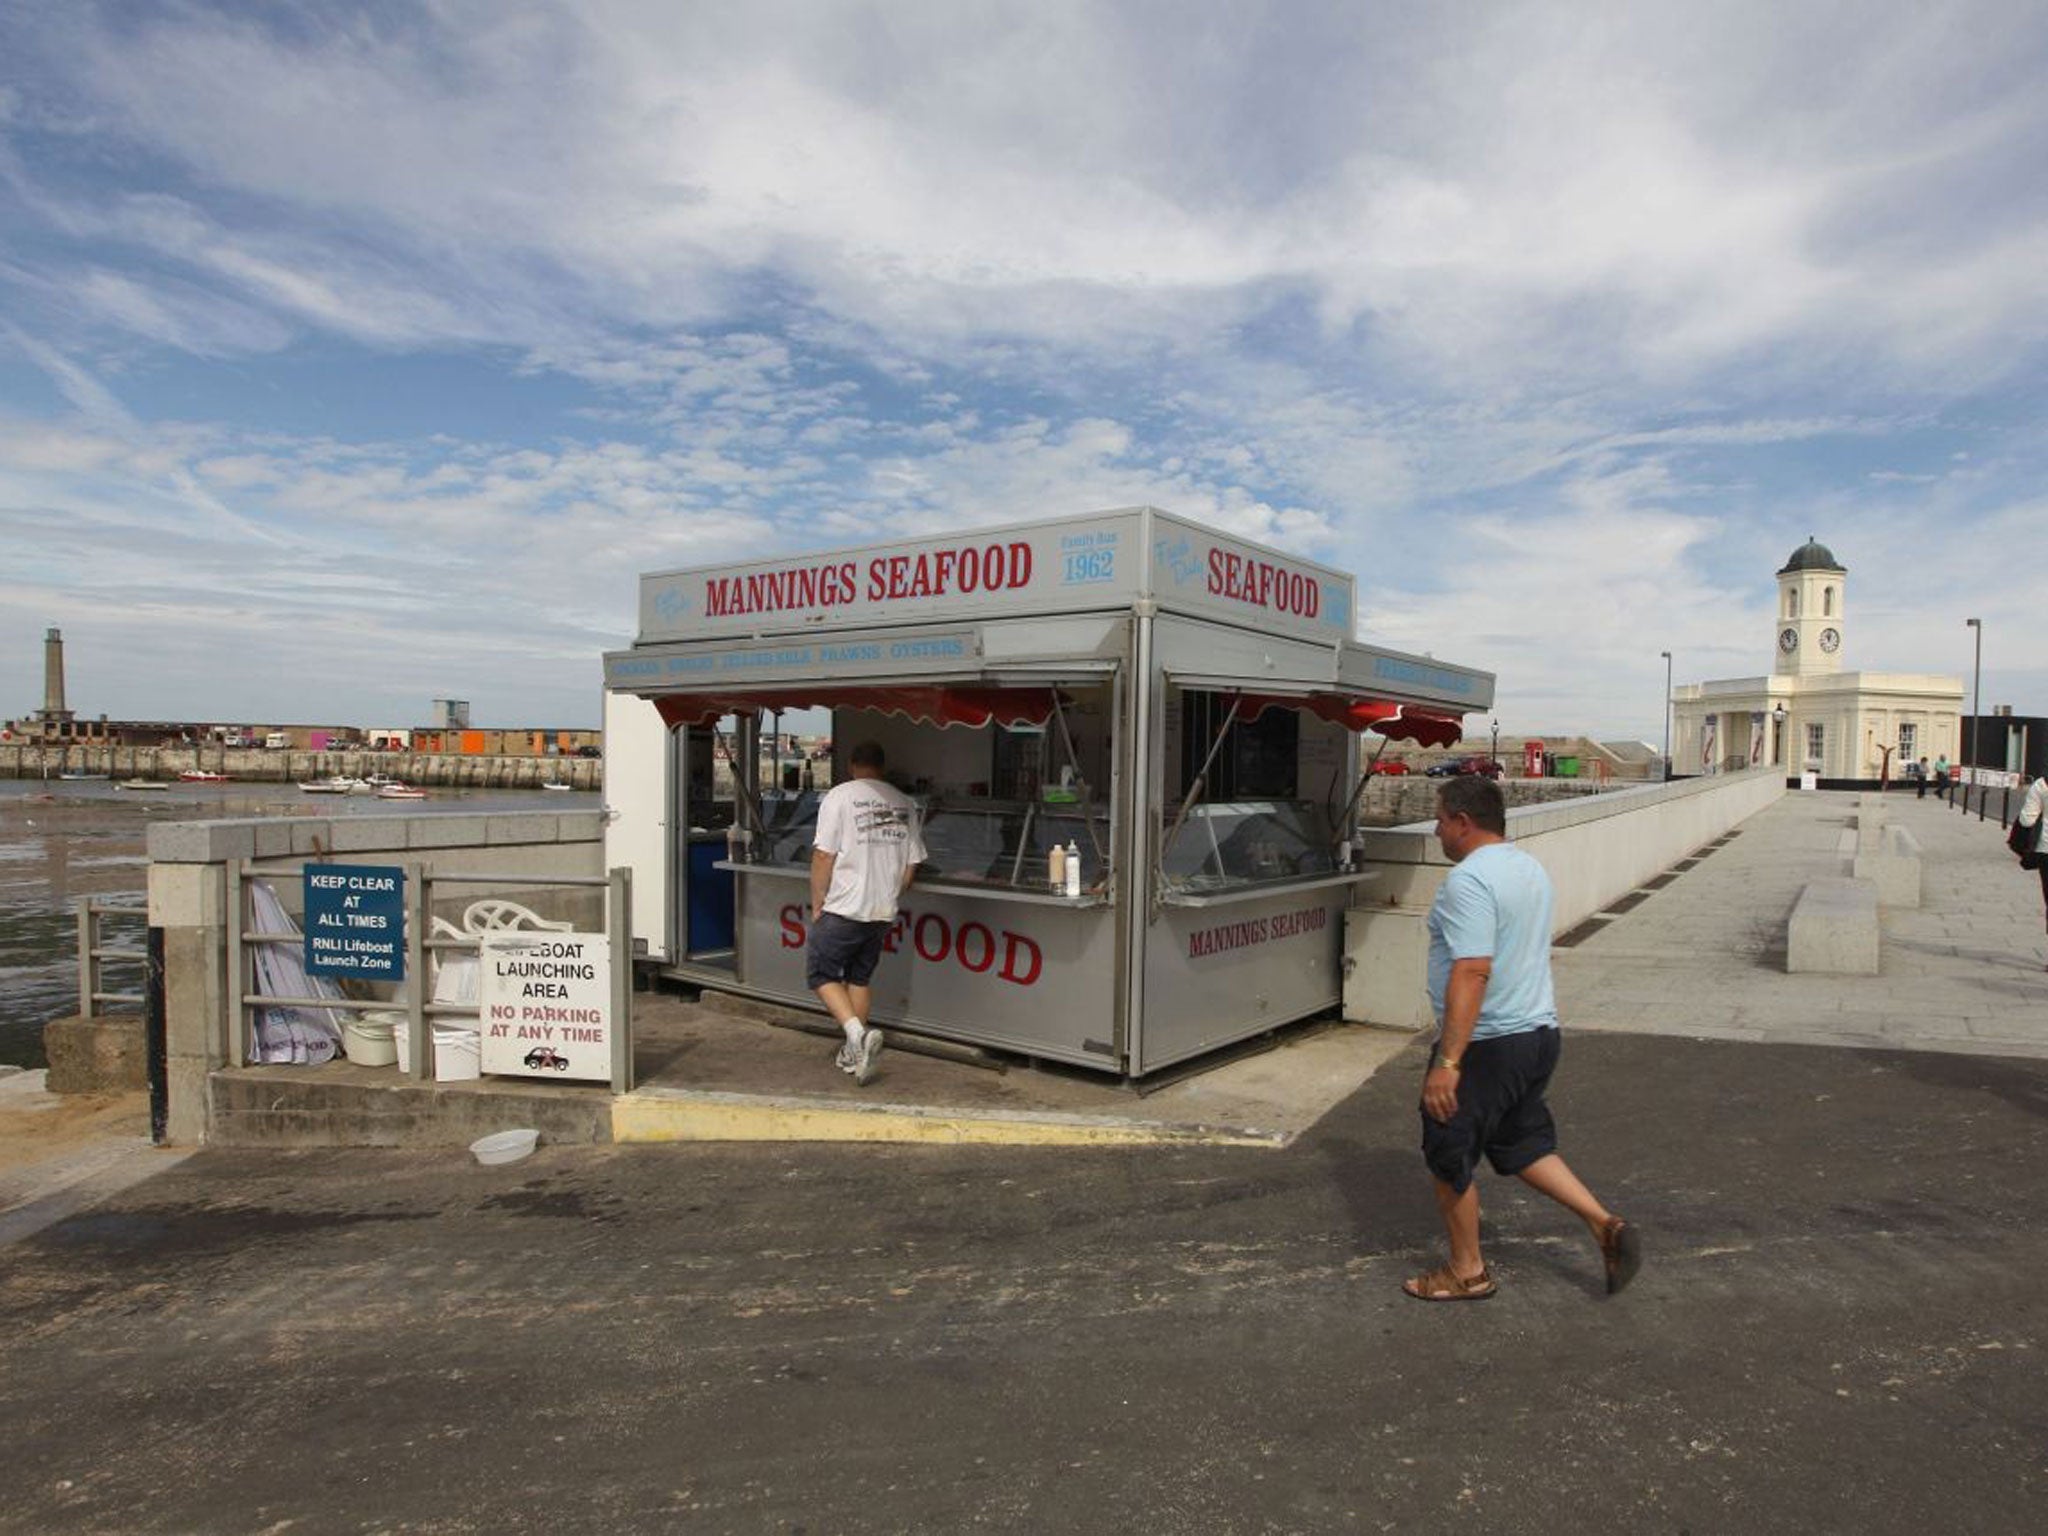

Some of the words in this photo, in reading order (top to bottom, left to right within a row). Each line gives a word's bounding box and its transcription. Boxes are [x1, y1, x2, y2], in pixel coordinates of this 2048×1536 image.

[1065, 551, 1114, 581] 1962
[705, 561, 856, 617] MANNINGS
[868, 542, 1032, 602] SEAFOOD
[1207, 547, 1318, 618] SEAFOOD
[889, 638, 964, 658] OYSTERS
[311, 875, 346, 888] KEEP
[349, 877, 394, 891] CLEAR
[343, 896, 361, 908] AT
[318, 914, 343, 926] ALL
[347, 914, 387, 928] TIMES
[1190, 918, 1267, 958] MANNINGS
[1271, 907, 1326, 940] SEAFOOD
[313, 937, 341, 950] RNLI
[345, 939, 393, 953] Lifeboat
[503, 943, 584, 958] BOAT
[779, 904, 1042, 986] SFOOD
[315, 954, 359, 967] Launch
[361, 956, 391, 969] Zone
[496, 962, 595, 980] LAUNCHING
[522, 983, 568, 998] AREA
[490, 1005, 515, 1019] NO
[522, 1006, 601, 1023] PARKING
[489, 1024, 510, 1037] AT
[517, 1025, 553, 1039] ANY
[561, 1027, 603, 1042] TIME
